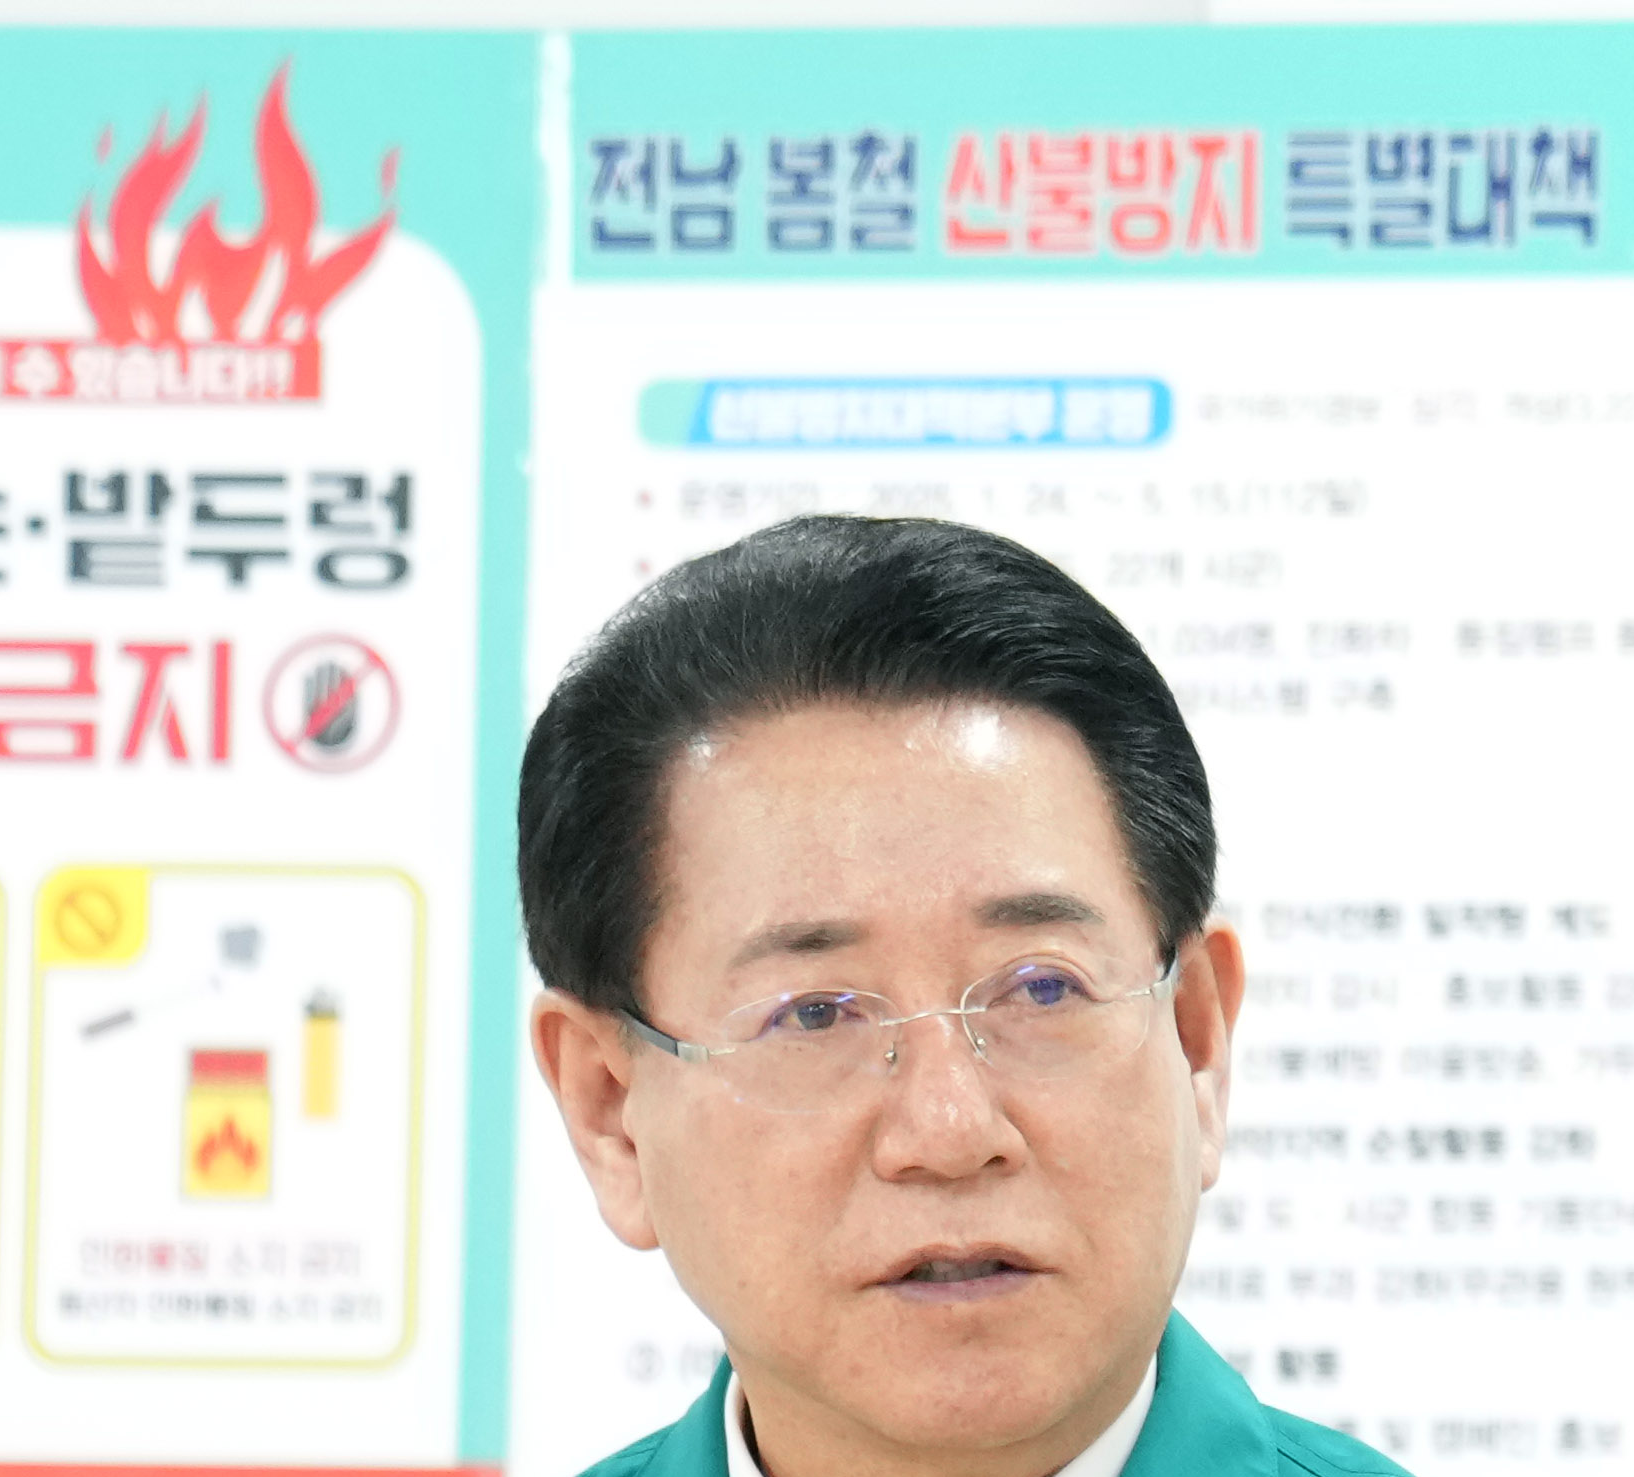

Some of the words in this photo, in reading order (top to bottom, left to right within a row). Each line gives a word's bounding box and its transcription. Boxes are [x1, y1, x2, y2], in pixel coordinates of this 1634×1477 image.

[588, 136, 740, 254] 전남
[767, 133, 920, 253] 봄철
[942, 131, 1261, 256] 산불방지
[1287, 129, 1600, 250] 특별대책
